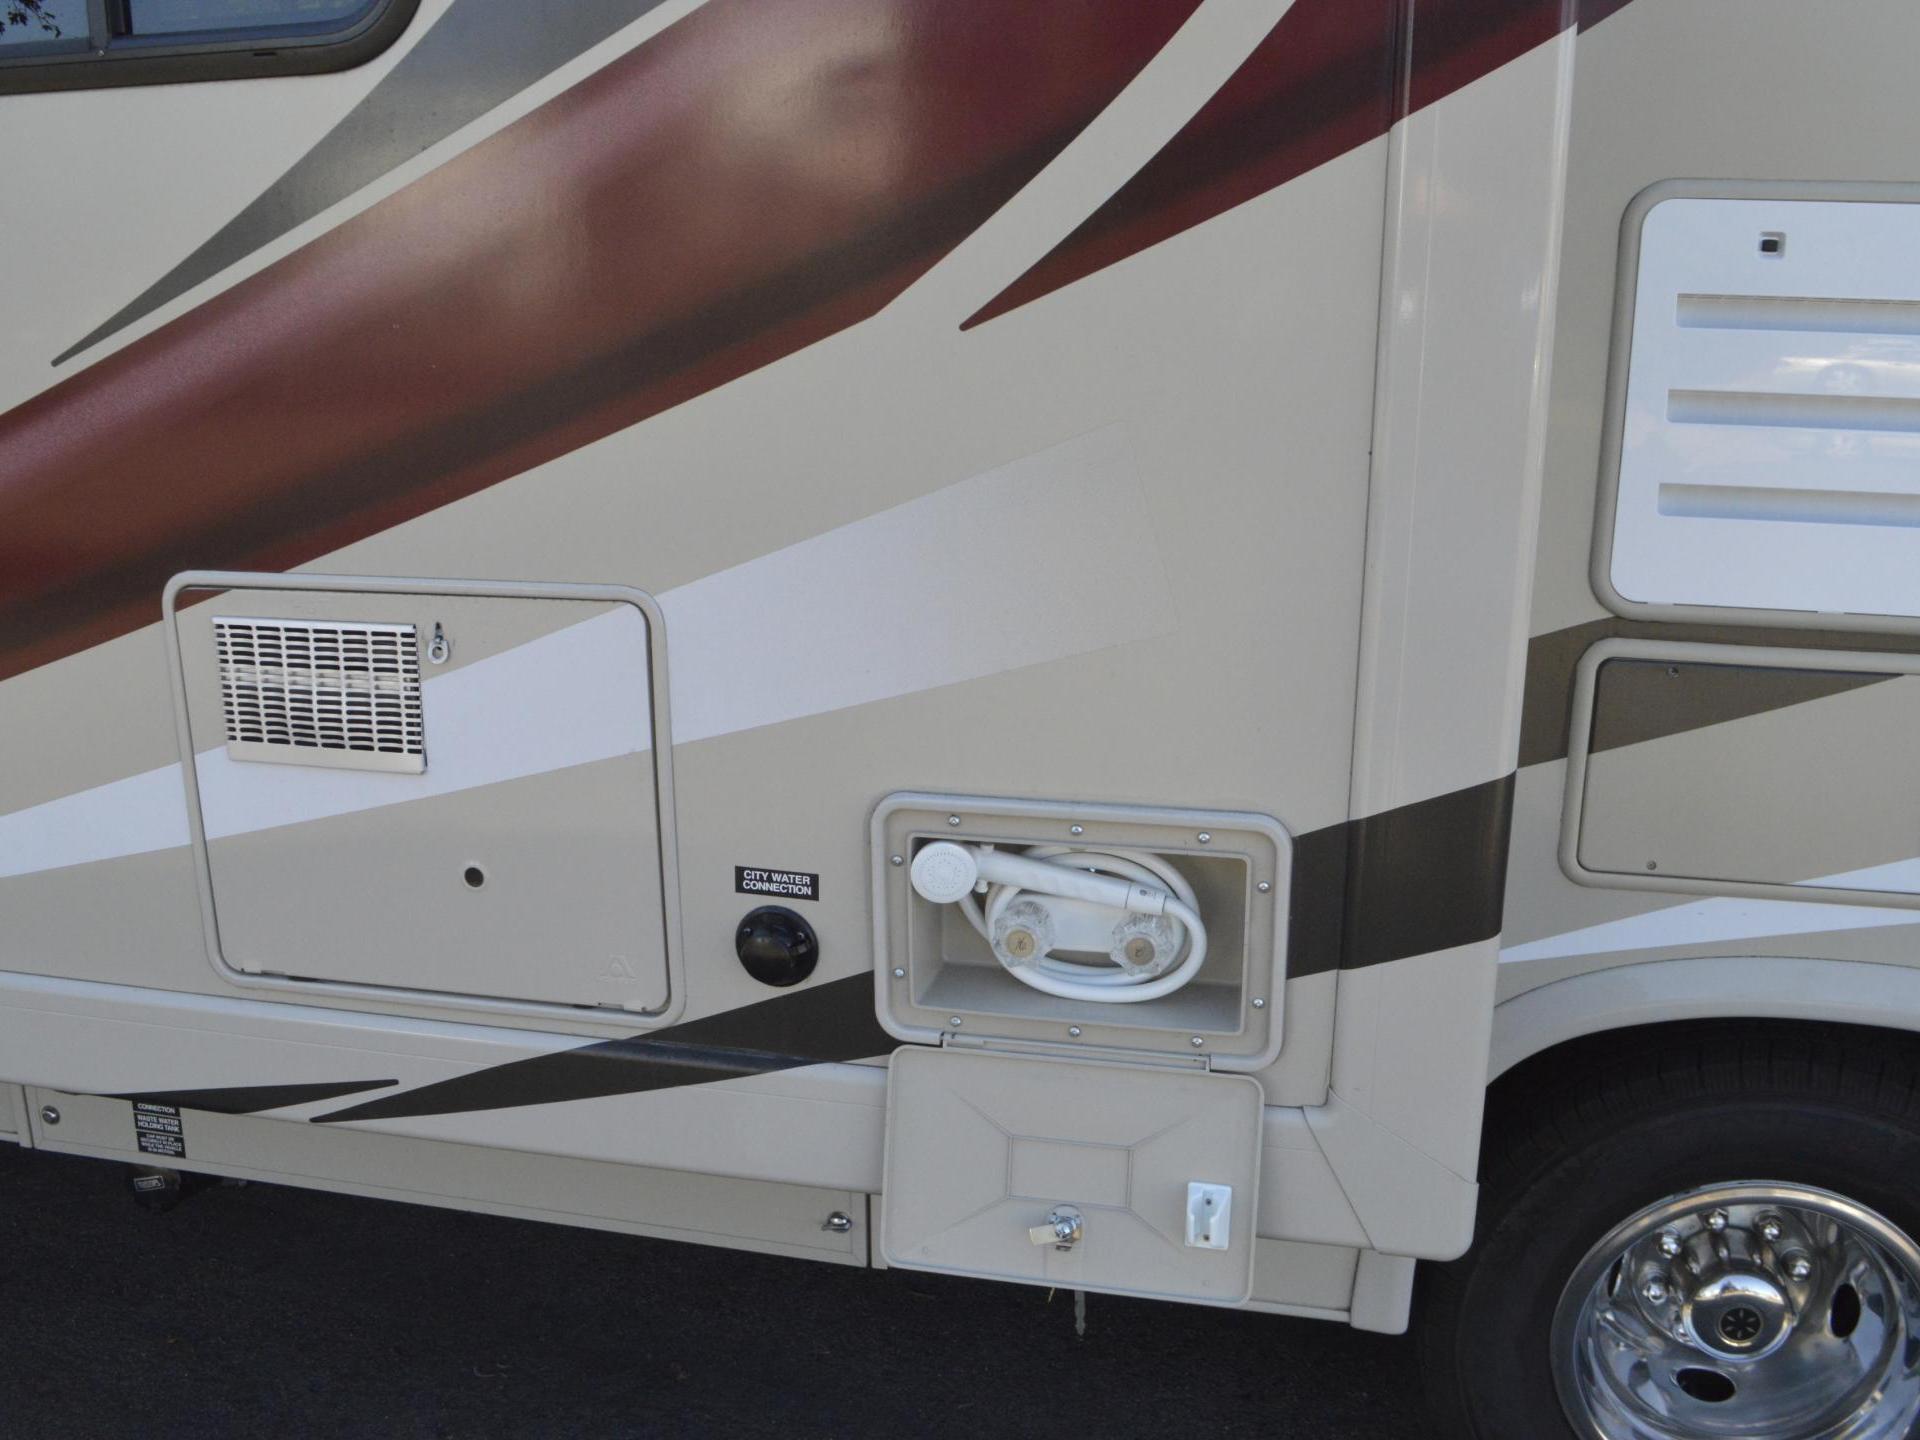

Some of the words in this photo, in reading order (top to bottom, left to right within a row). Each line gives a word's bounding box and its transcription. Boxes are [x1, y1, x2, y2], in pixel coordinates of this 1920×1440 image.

[744, 870, 769, 881] CITY
[771, 872, 811, 885] WATER
[742, 880, 812, 896] CONNECTION
[137, 1103, 176, 1114] CONNECTION
[137, 1114, 158, 1123] WASTE
[158, 1117, 179, 1126] WATER
[137, 1121, 164, 1130] HOLDING
[164, 1124, 180, 1133] TANK
